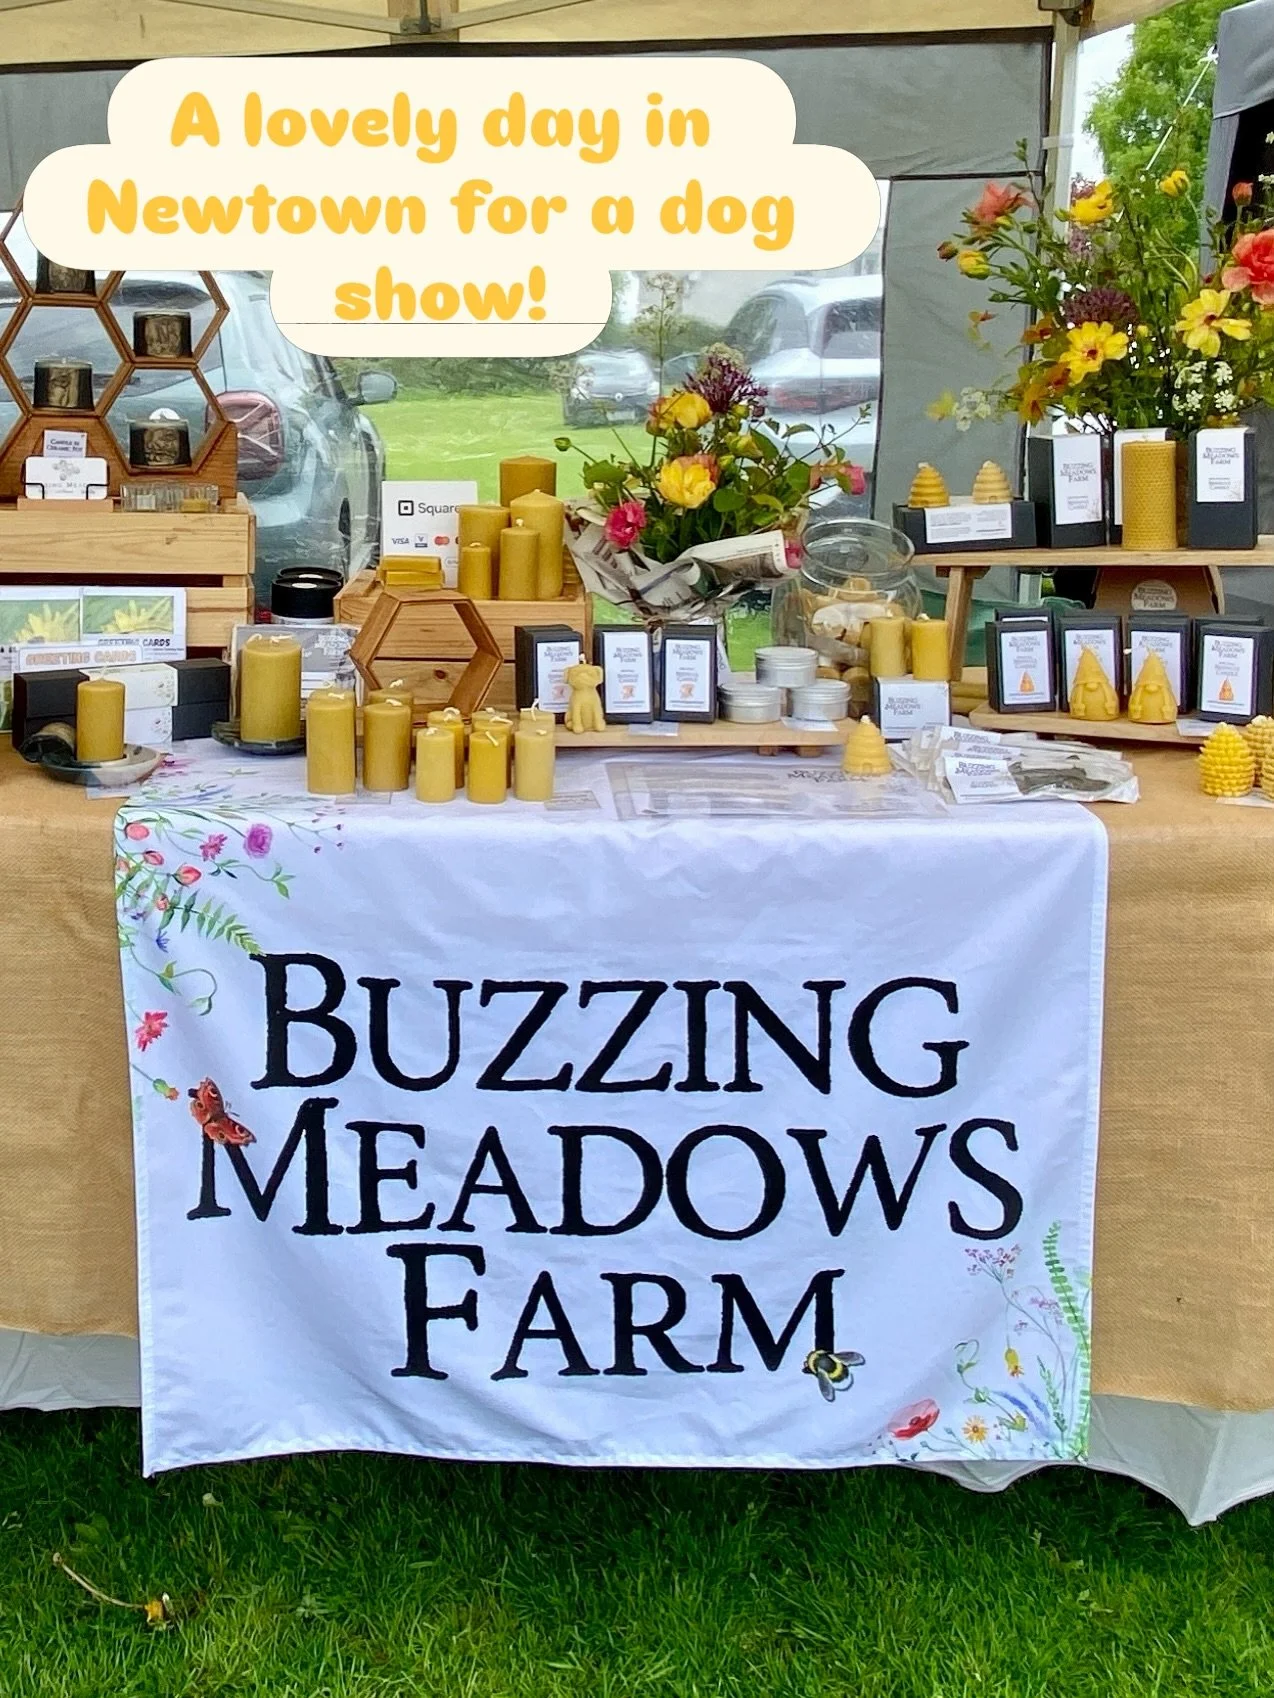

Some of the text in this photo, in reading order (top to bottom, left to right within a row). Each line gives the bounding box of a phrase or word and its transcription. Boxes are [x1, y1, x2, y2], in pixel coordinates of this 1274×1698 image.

[391, 537, 410, 545] VISA
[143, 638, 171, 647] CARDS
[249, 952, 970, 1099] BUZZING
[187, 1097, 1024, 1241] MEADOWS
[386, 1242, 846, 1380] FARM
